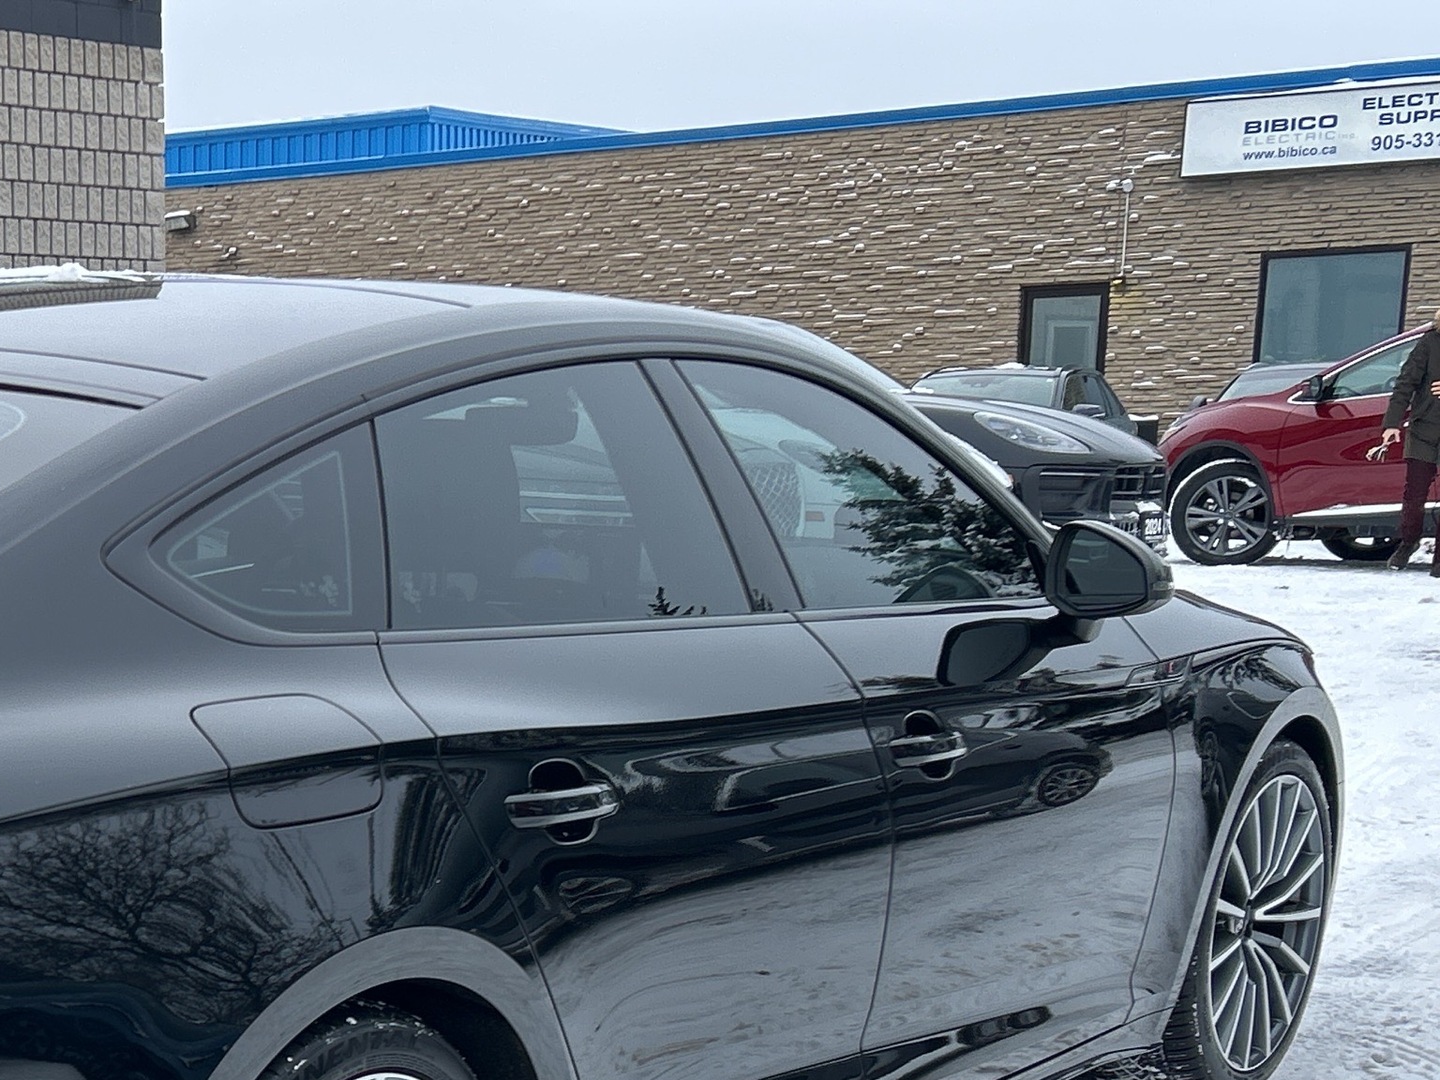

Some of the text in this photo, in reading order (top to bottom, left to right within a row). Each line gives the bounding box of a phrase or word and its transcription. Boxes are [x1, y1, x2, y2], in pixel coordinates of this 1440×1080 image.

[1244, 114, 1338, 134] BIBICO
[1242, 130, 1337, 146] ELECTRIC
[1243, 144, 1338, 161] www.bibico.ca
